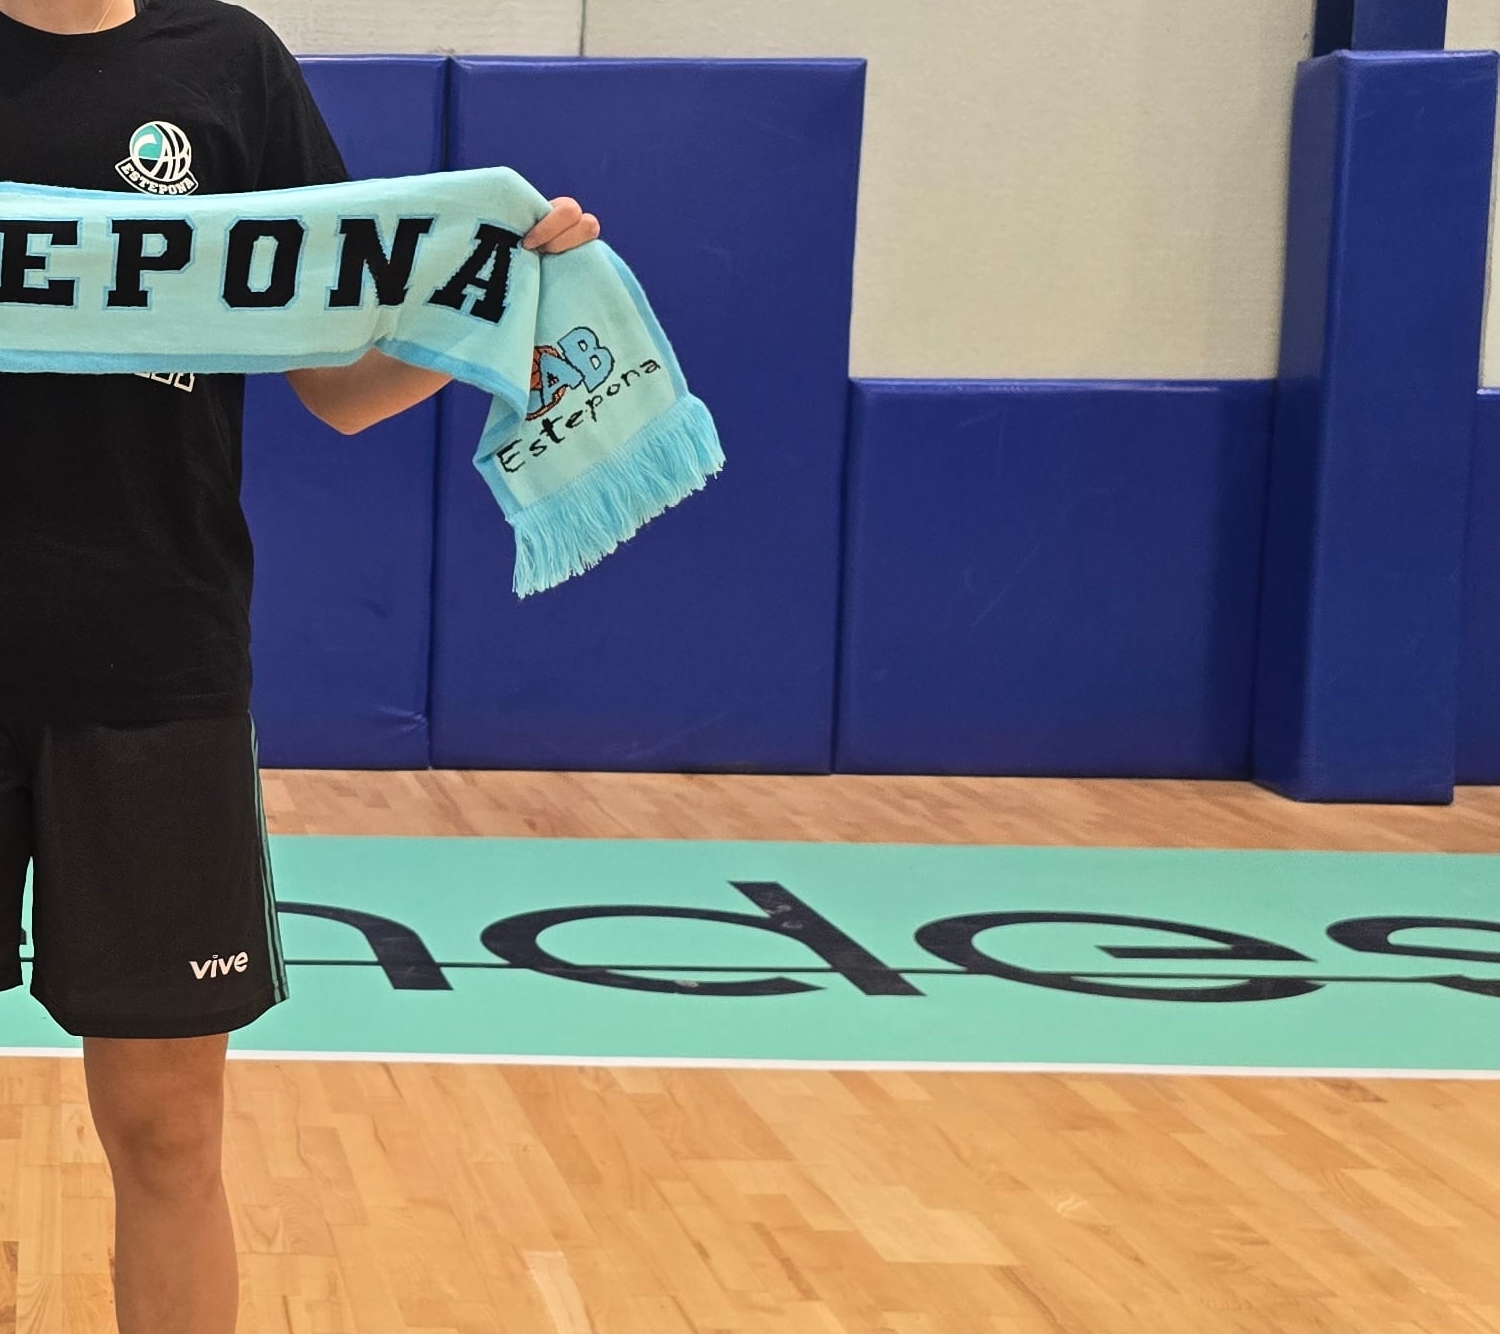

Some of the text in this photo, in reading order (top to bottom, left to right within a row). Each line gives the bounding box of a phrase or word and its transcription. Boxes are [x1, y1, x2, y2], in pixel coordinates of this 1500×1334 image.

[120, 163, 195, 194] ESTEPONA
[526, 326, 615, 417] AB
[496, 359, 661, 473] Estepona
[189, 951, 249, 979] vive
